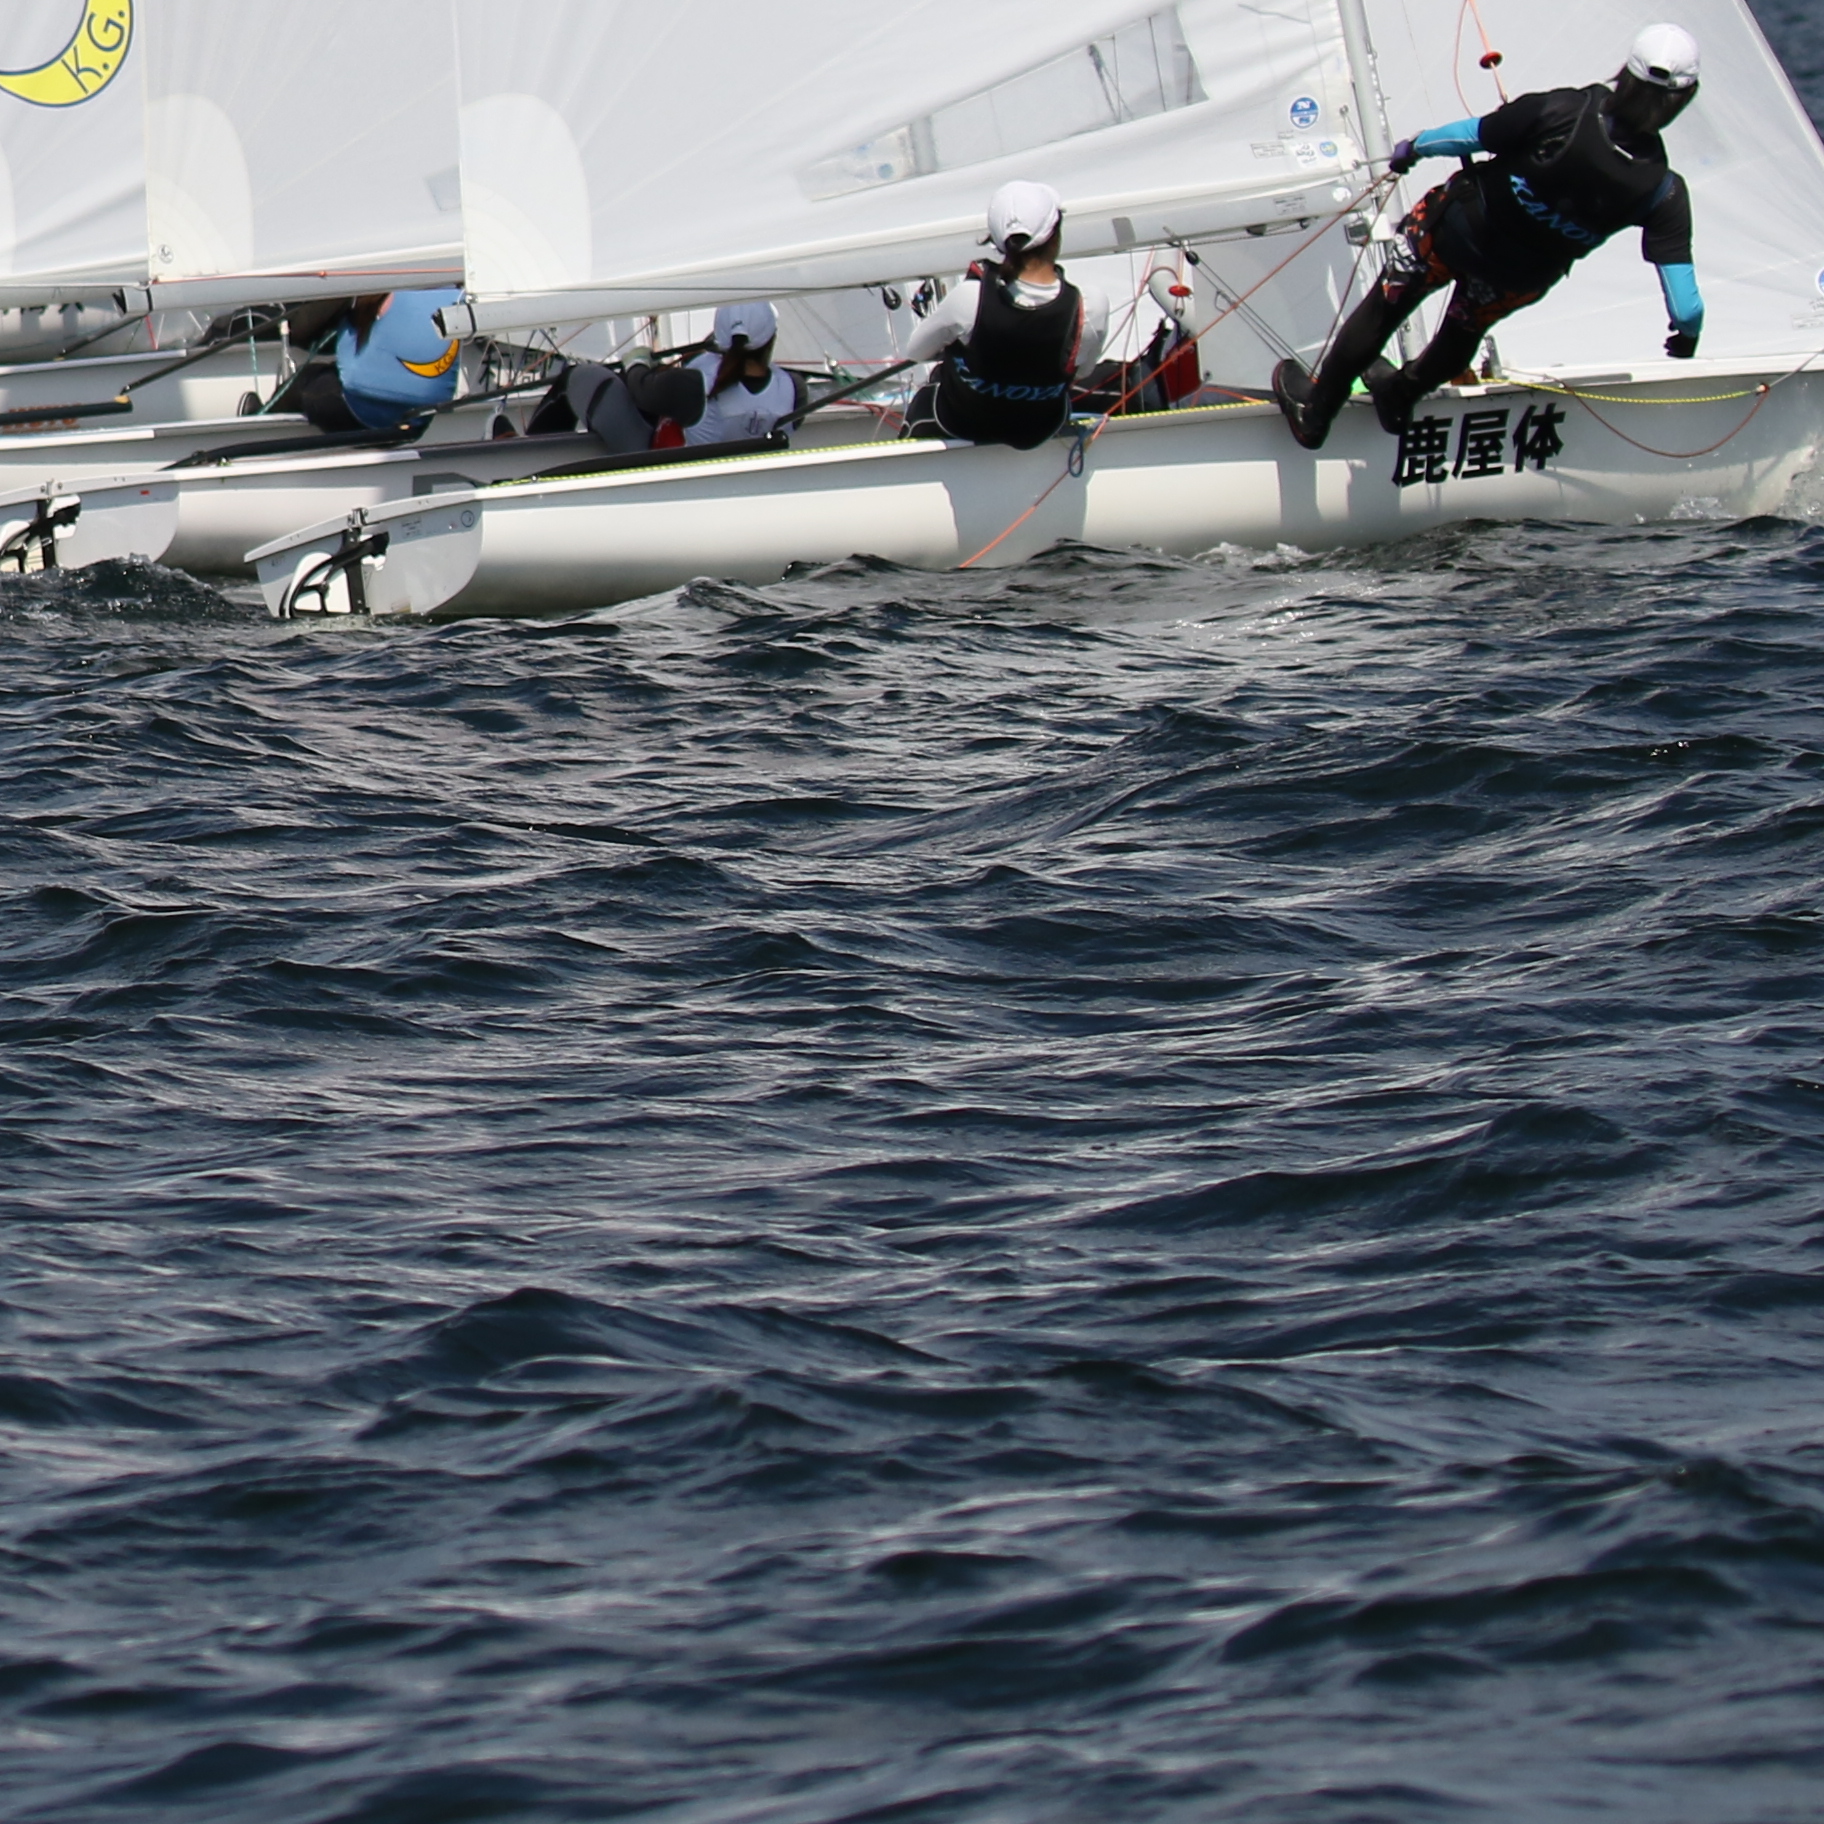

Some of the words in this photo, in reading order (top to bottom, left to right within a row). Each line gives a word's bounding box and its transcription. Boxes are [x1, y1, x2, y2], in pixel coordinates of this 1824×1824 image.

[61, 9, 126, 95] K.G.
[953, 357, 1066, 401] KANOYA
[1392, 402, 1567, 488] 鹿屋体
